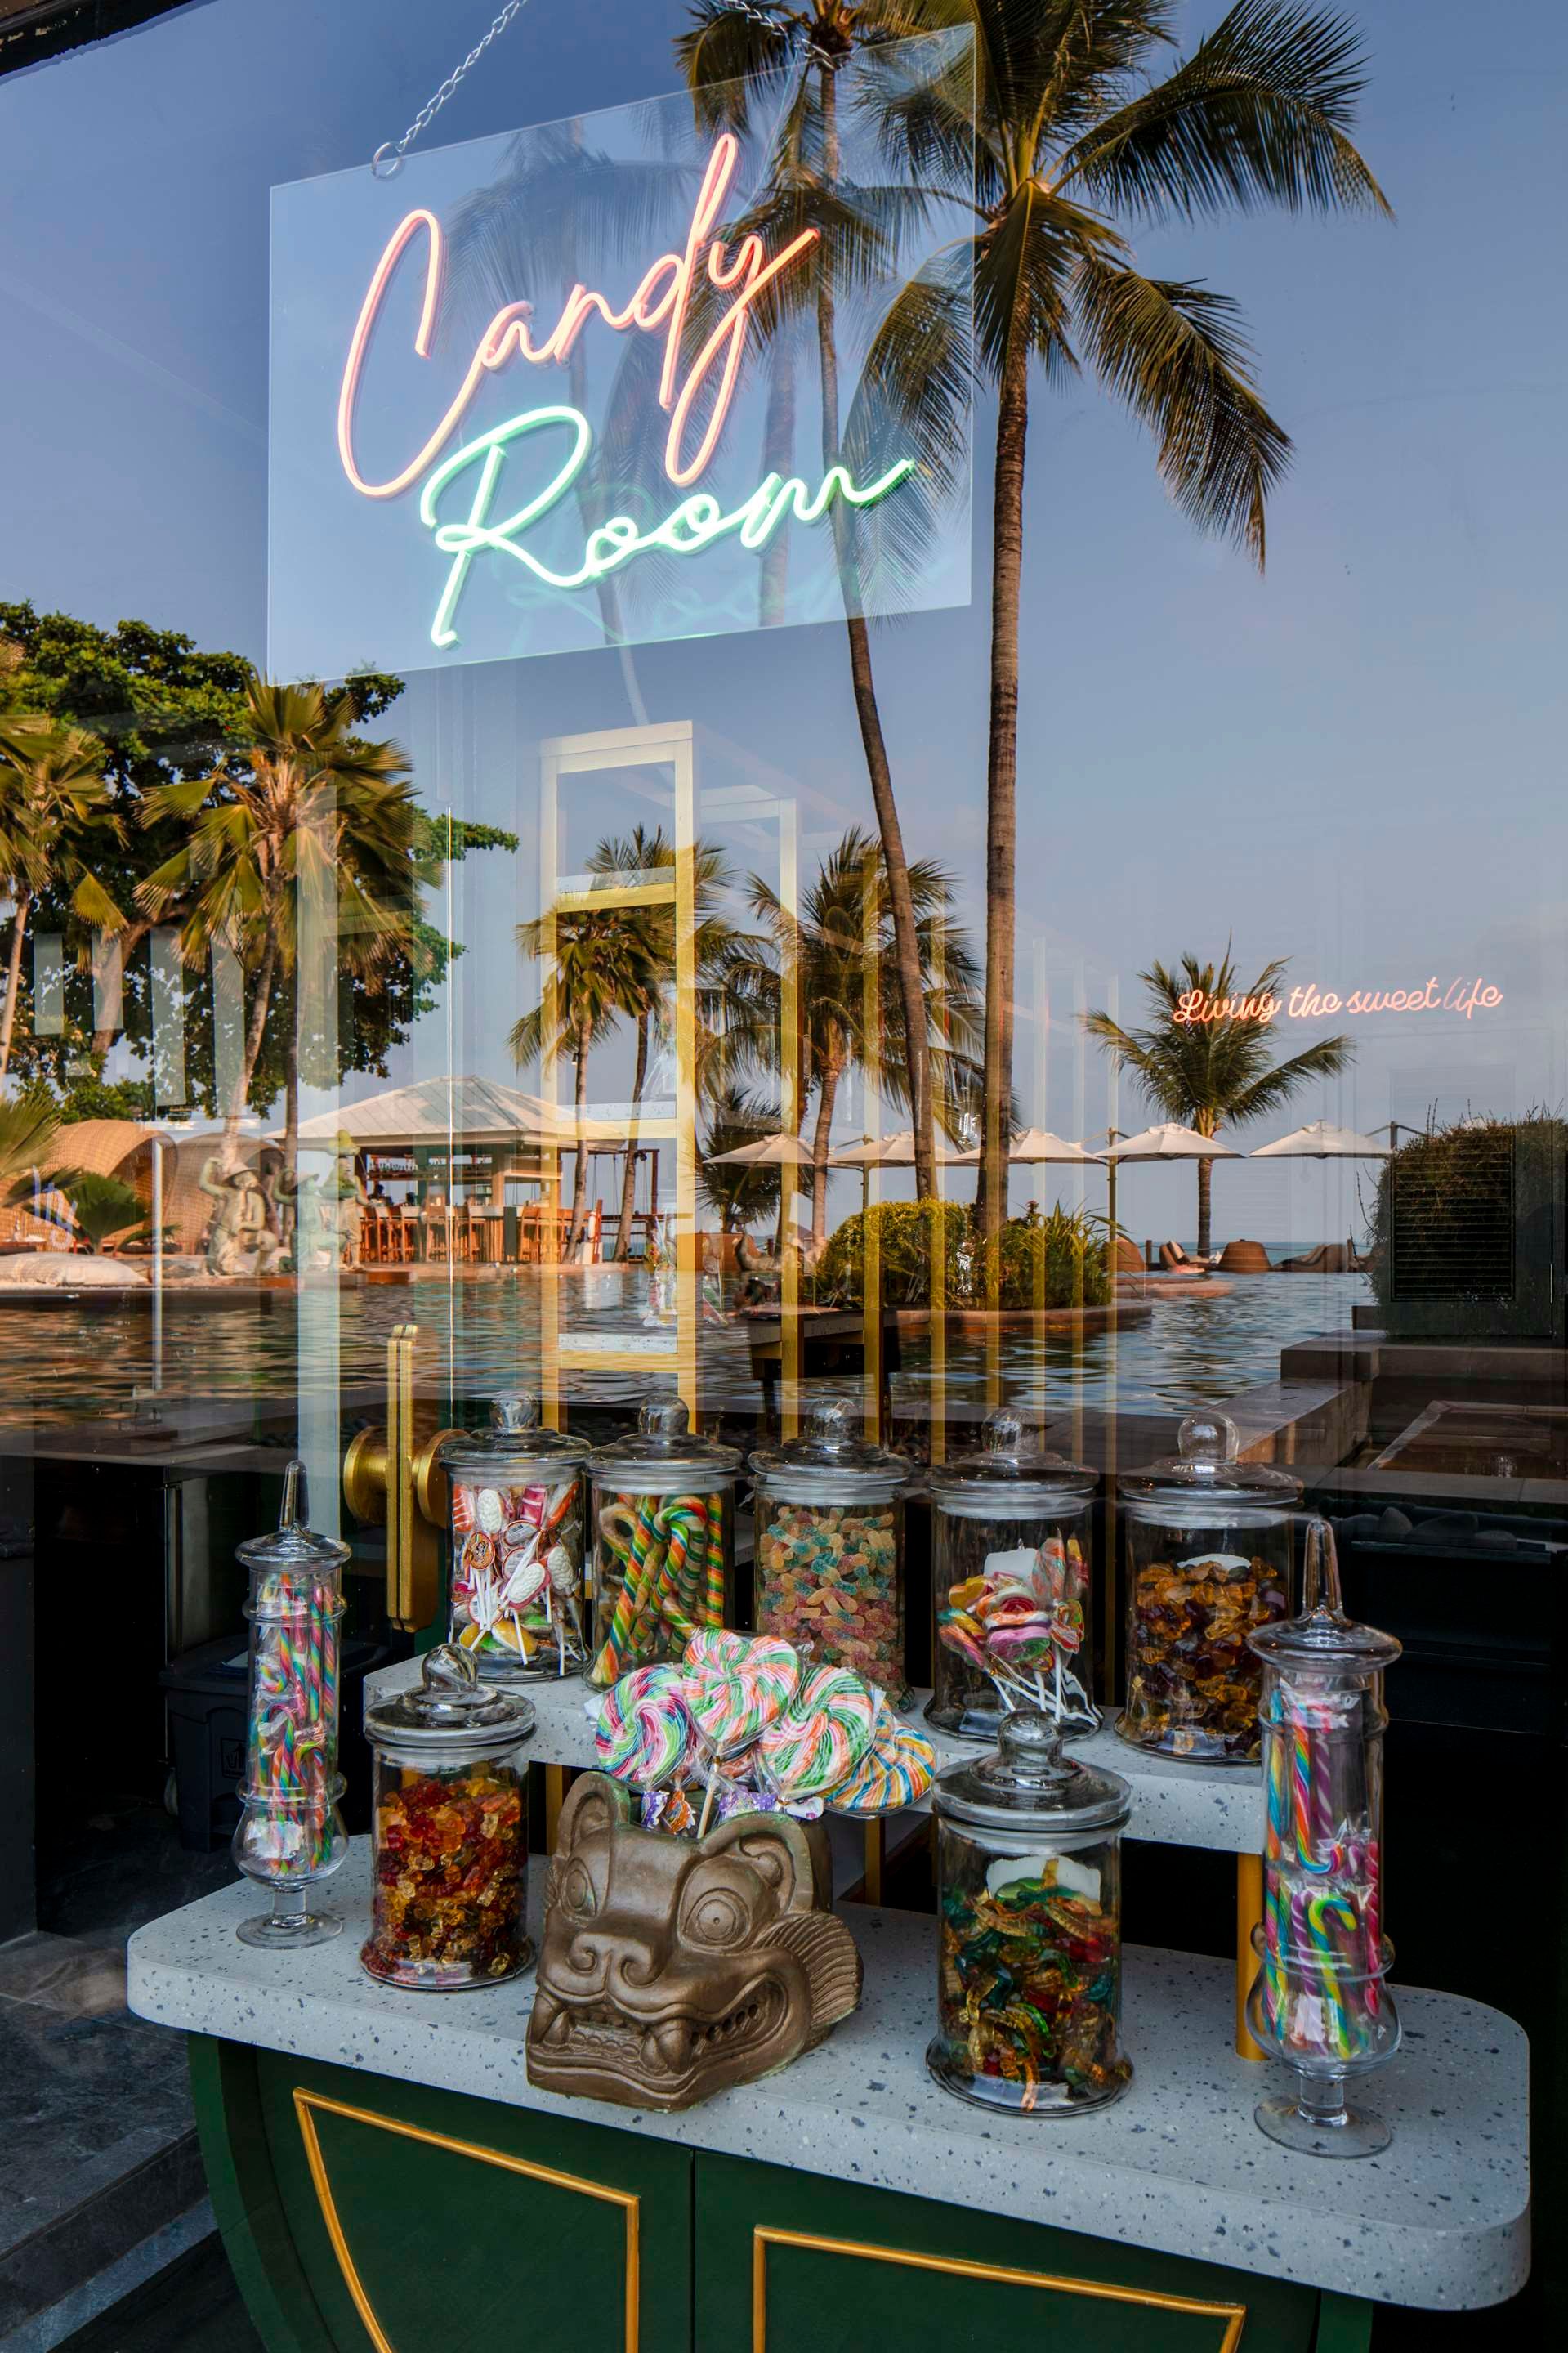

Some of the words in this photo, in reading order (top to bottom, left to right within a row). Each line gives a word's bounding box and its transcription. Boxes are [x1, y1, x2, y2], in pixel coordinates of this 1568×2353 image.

[337, 132, 820, 500] Candy
[419, 405, 918, 649] Room
[1173, 987, 1282, 1023] Living
[1289, 983, 1342, 1018] the
[1345, 976, 1441, 1013] sweet
[1441, 976, 1504, 1019] life
